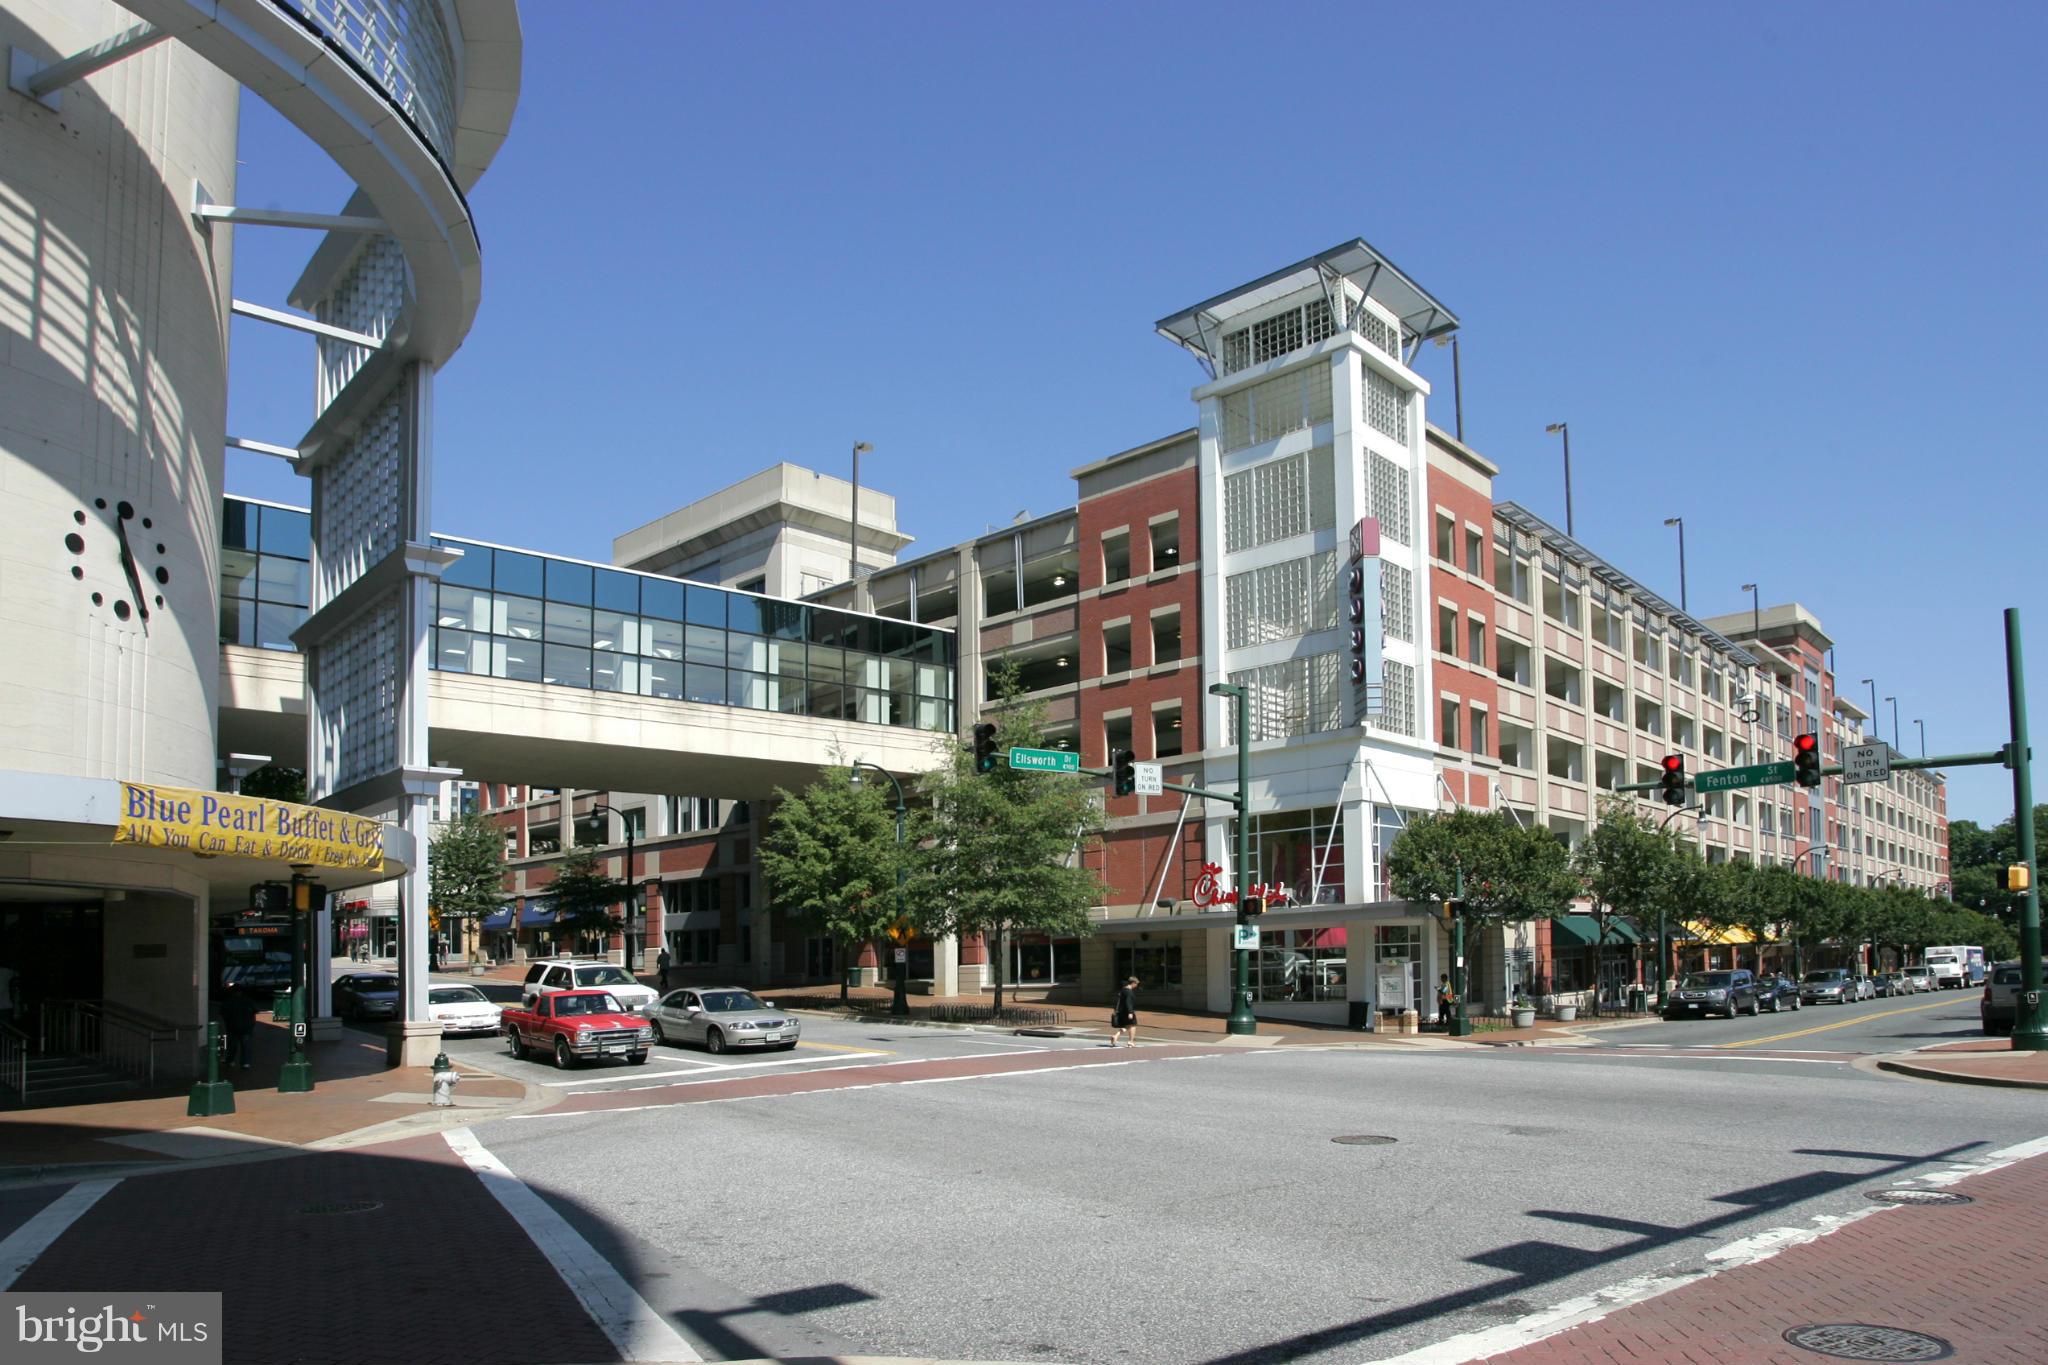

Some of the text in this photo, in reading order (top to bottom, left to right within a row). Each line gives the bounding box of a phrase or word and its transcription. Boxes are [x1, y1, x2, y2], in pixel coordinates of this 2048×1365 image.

[1857, 749, 1874, 758] NO
[1015, 753, 1072, 766] Ellsworth Dr
[1853, 759, 1880, 769] TURN
[1767, 766, 1778, 775] St
[1846, 768, 1887, 780] ON RED
[1141, 775, 1157, 783] TURN
[1706, 774, 1747, 788] Fenton
[1137, 783, 1146, 791] ON
[127, 785, 191, 825] Blue
[201, 795, 265, 833] Pearl
[277, 806, 334, 842] Buffet
[339, 816, 351, 845] &
[127, 823, 152, 843] All
[163, 827, 190, 849] You
[199, 831, 226, 853] Can
[234, 835, 258, 855] Eat
[262, 838, 273, 857] &
[279, 840, 312, 861] Drink
